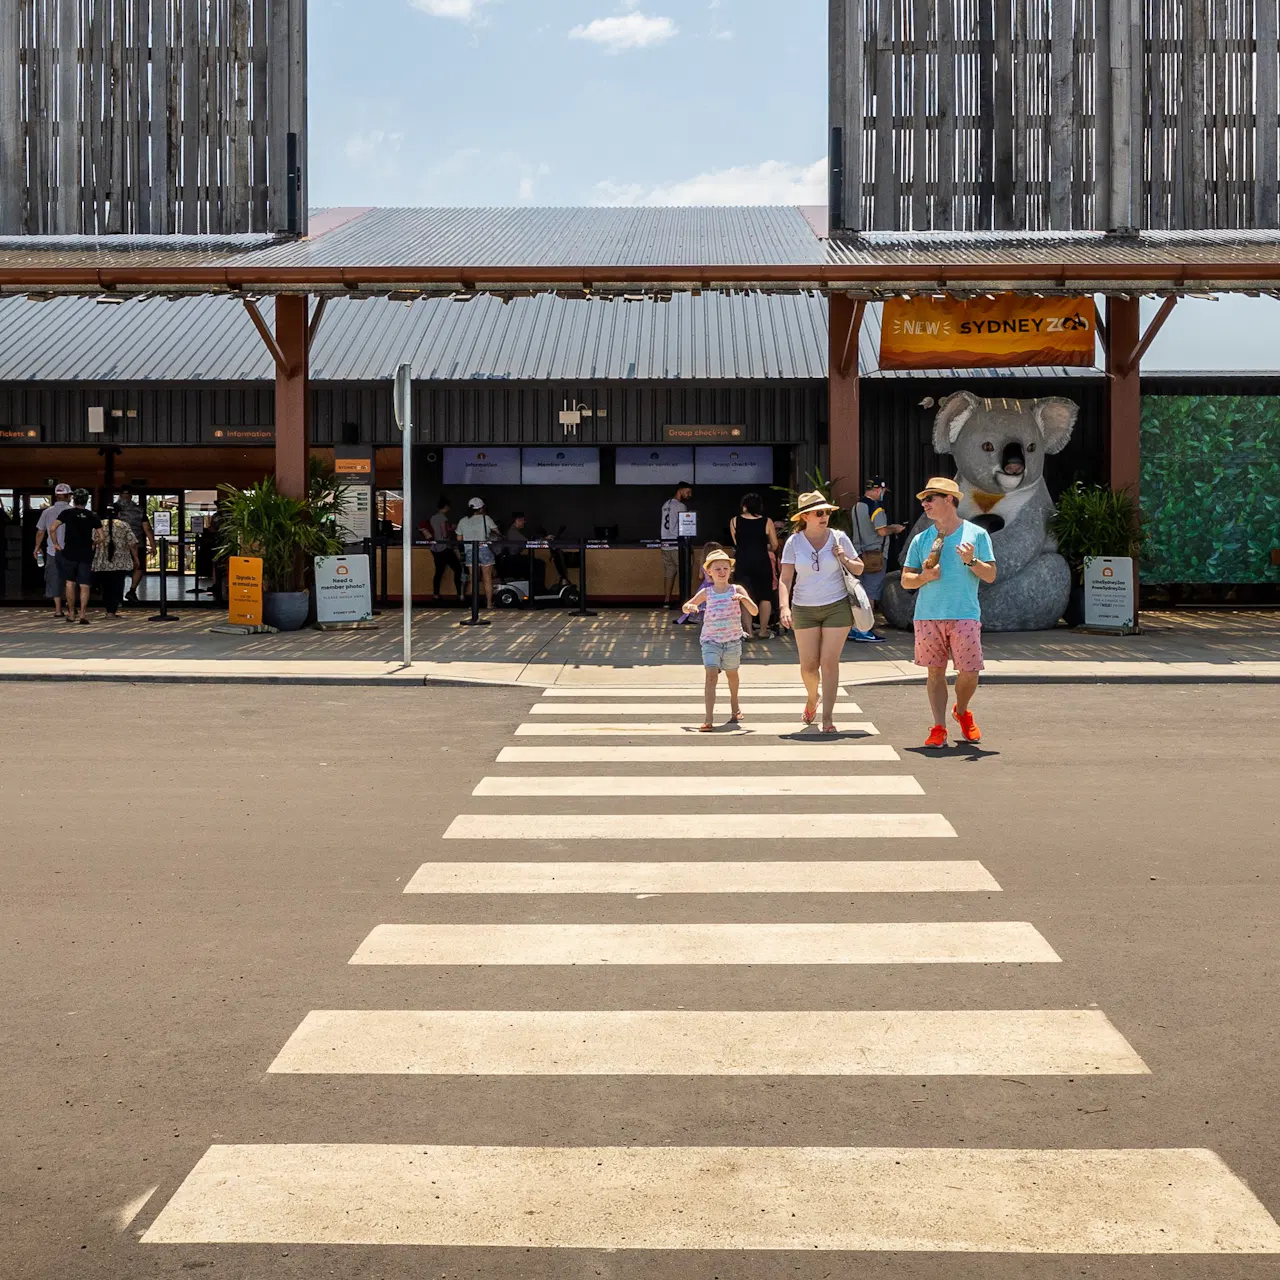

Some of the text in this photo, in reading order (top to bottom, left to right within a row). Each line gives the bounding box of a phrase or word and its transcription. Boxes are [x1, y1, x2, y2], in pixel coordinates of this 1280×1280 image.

[903, 320, 940, 335] NEW
[960, 318, 1044, 334] SYDNEY
[668, 429, 693, 437] Group
